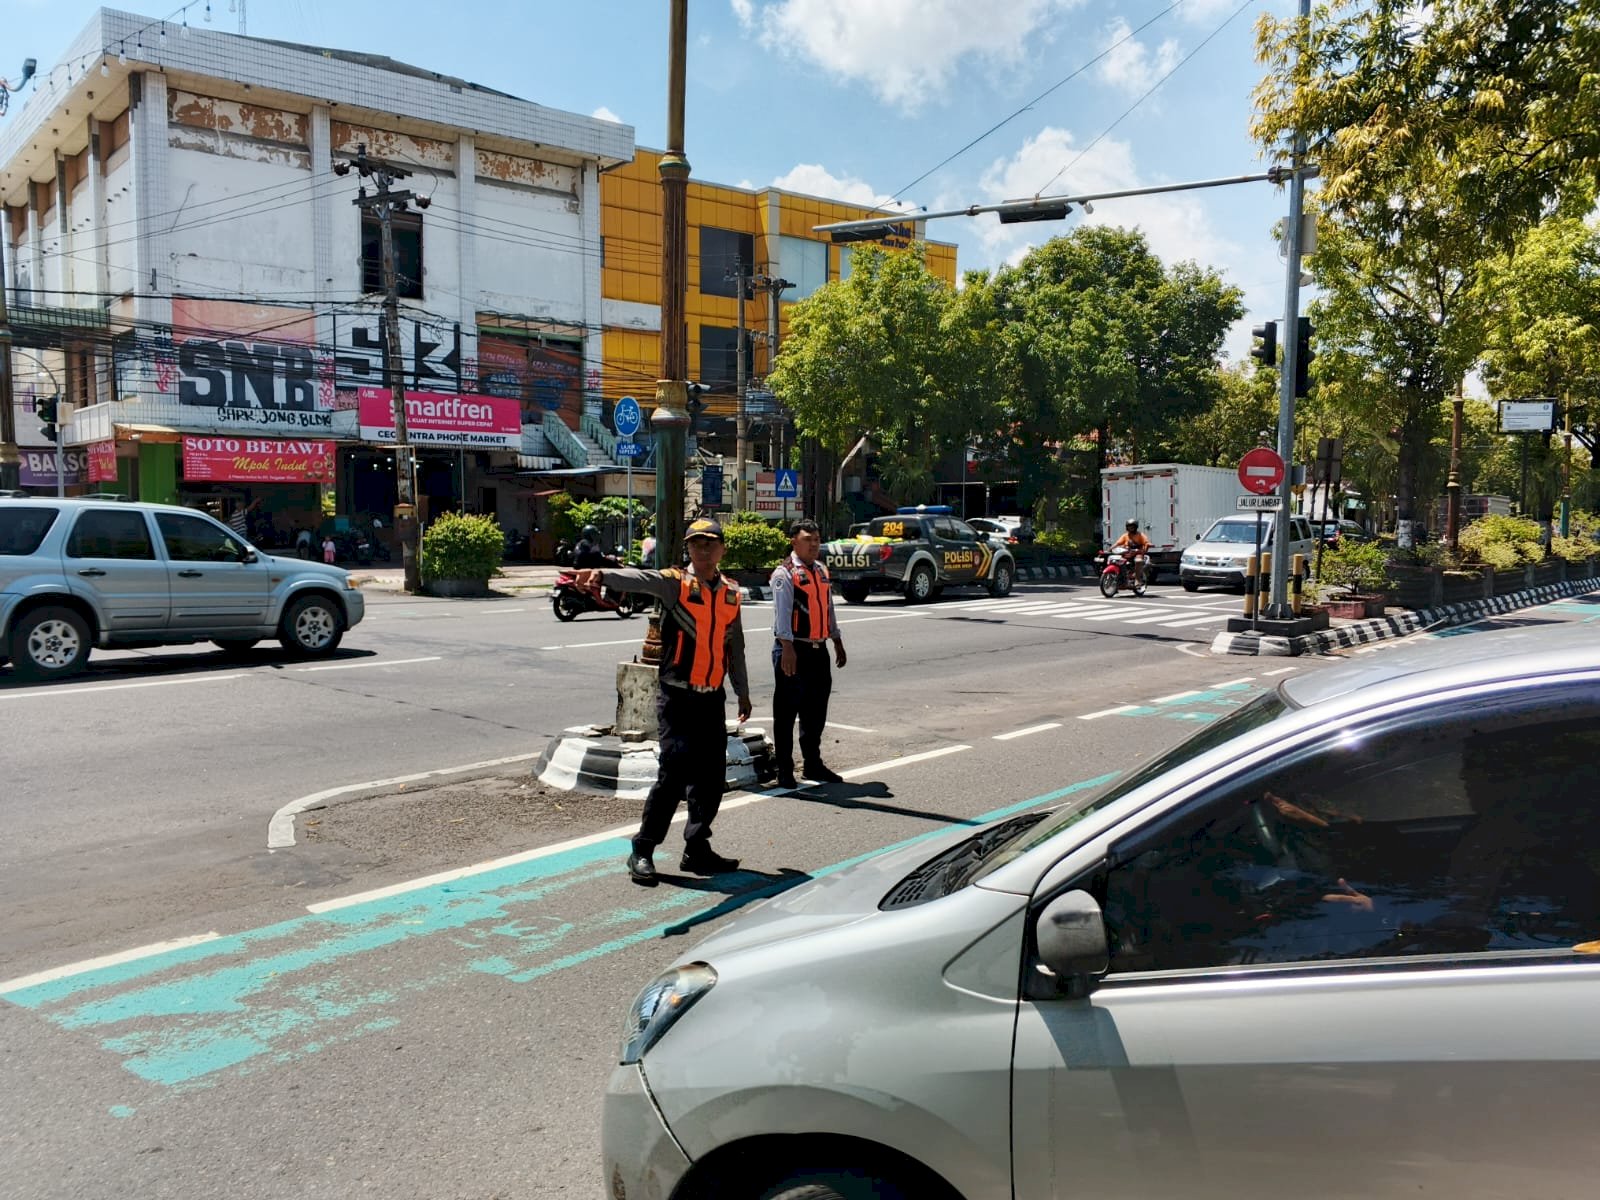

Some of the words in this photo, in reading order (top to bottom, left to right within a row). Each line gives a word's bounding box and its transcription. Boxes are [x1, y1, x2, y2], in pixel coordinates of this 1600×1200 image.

[436, 433, 469, 442] PHONE
[470, 434, 507, 444] MARKET
[185, 438, 240, 452] SOTO
[246, 440, 325, 455] BETAWI
[232, 456, 270, 472] Mpok
[882, 521, 904, 532] 204
[826, 555, 870, 568] POLISI
[944, 551, 973, 563] POLISI
